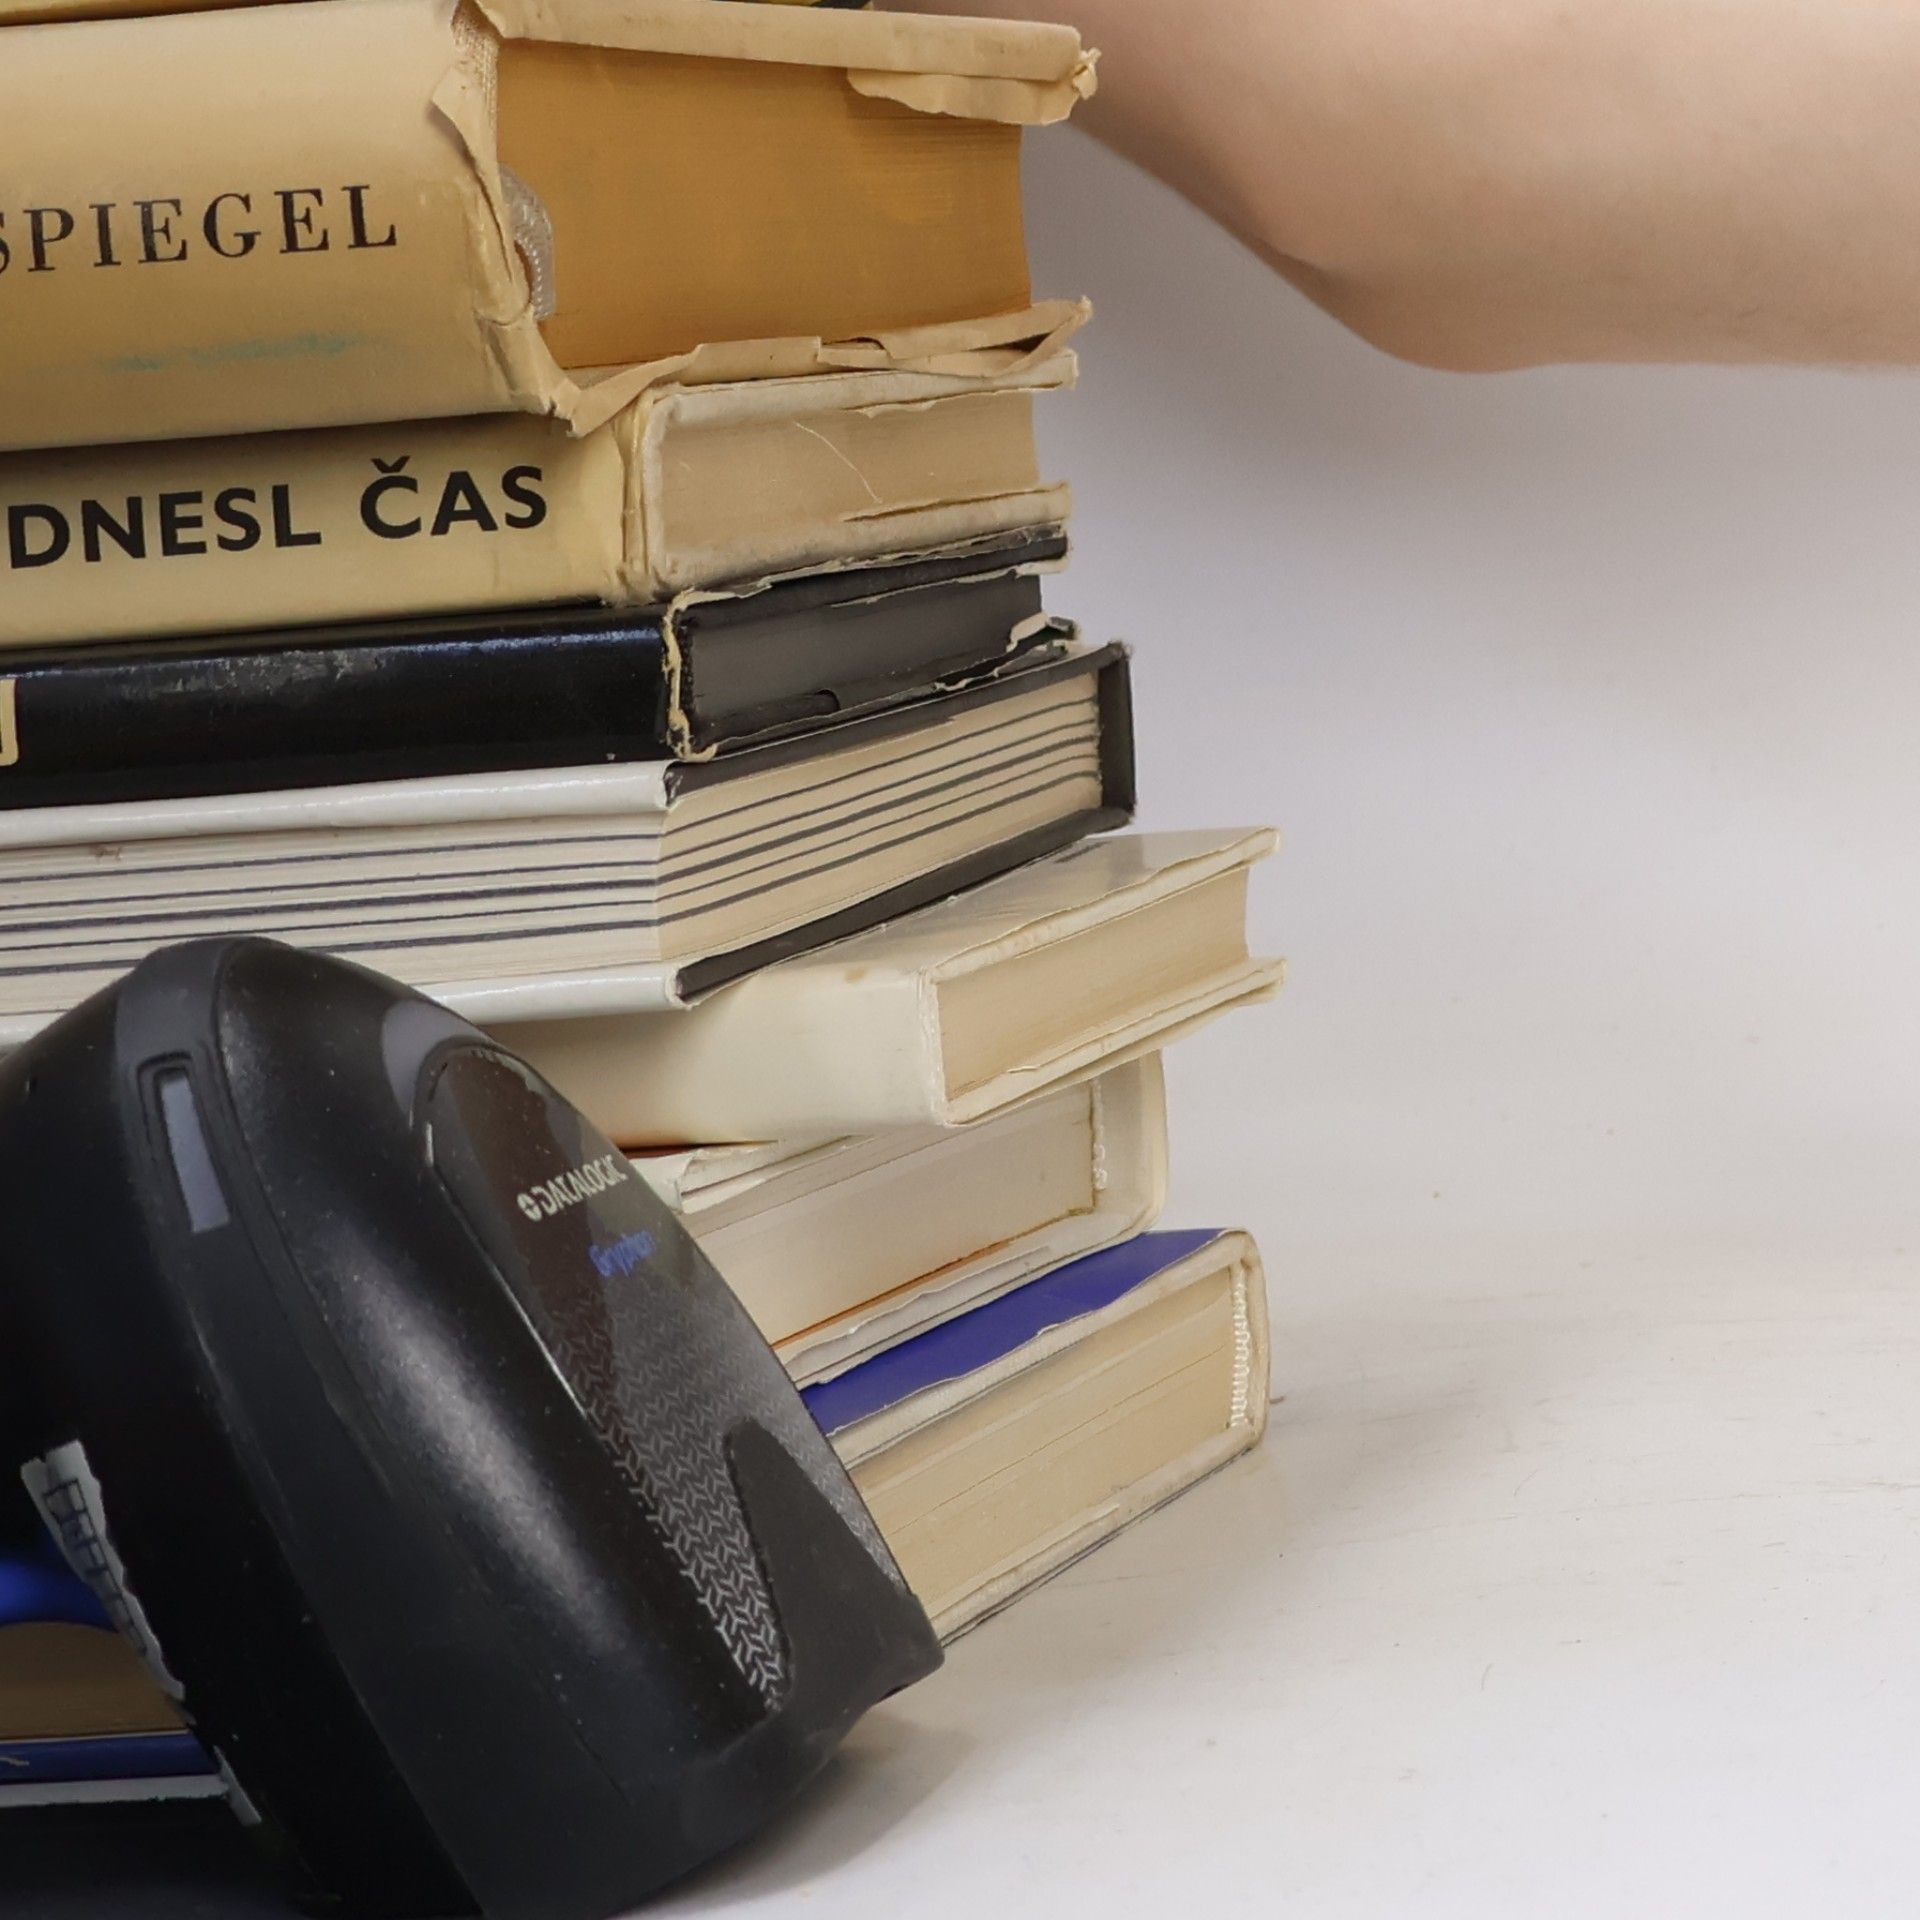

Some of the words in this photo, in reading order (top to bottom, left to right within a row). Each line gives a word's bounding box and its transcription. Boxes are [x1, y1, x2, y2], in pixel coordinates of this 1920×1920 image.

[0, 184, 397, 275] PIEGEL
[7, 484, 322, 569] DNESL
[360, 455, 548, 540] ČAS
